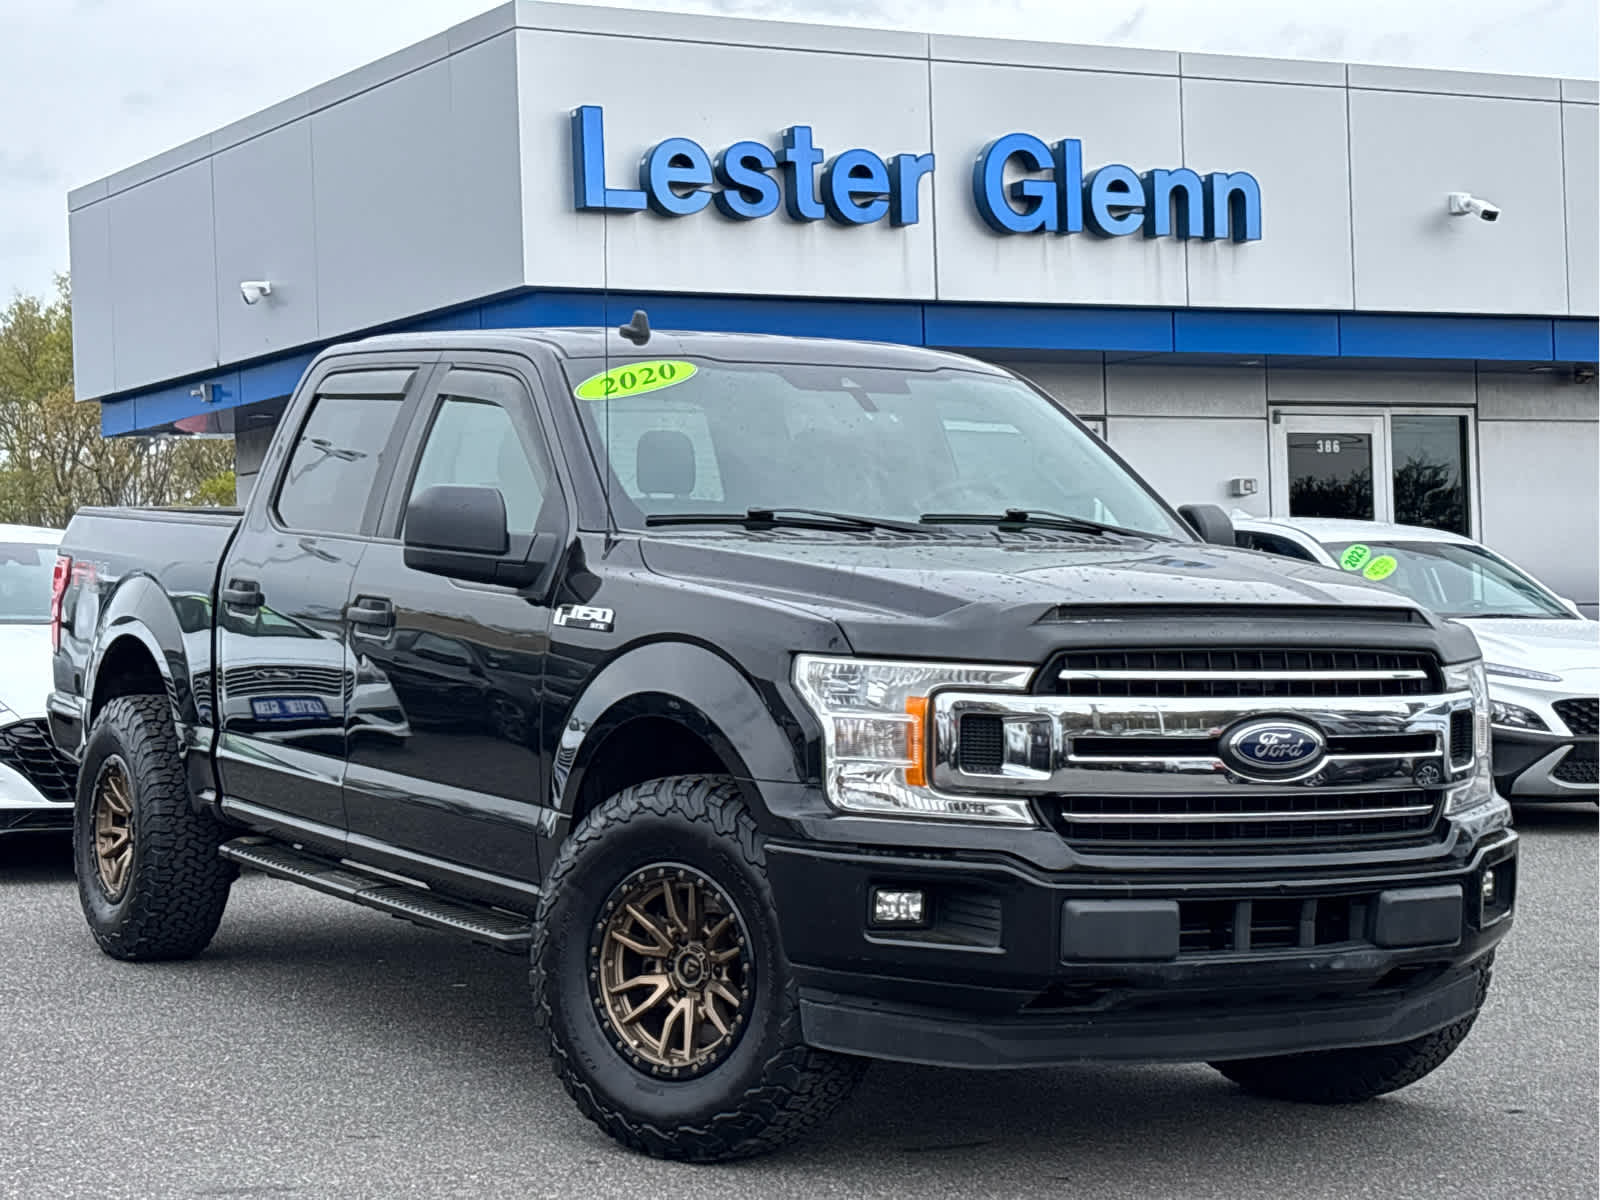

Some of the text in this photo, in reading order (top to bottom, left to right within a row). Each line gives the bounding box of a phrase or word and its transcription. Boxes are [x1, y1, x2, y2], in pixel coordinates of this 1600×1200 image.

[572, 105, 1262, 242] Lester Glenn
[600, 363, 676, 396] 2020
[1316, 439, 1341, 453] 386
[1344, 546, 1368, 568] 2023
[1254, 732, 1304, 757] Ford
